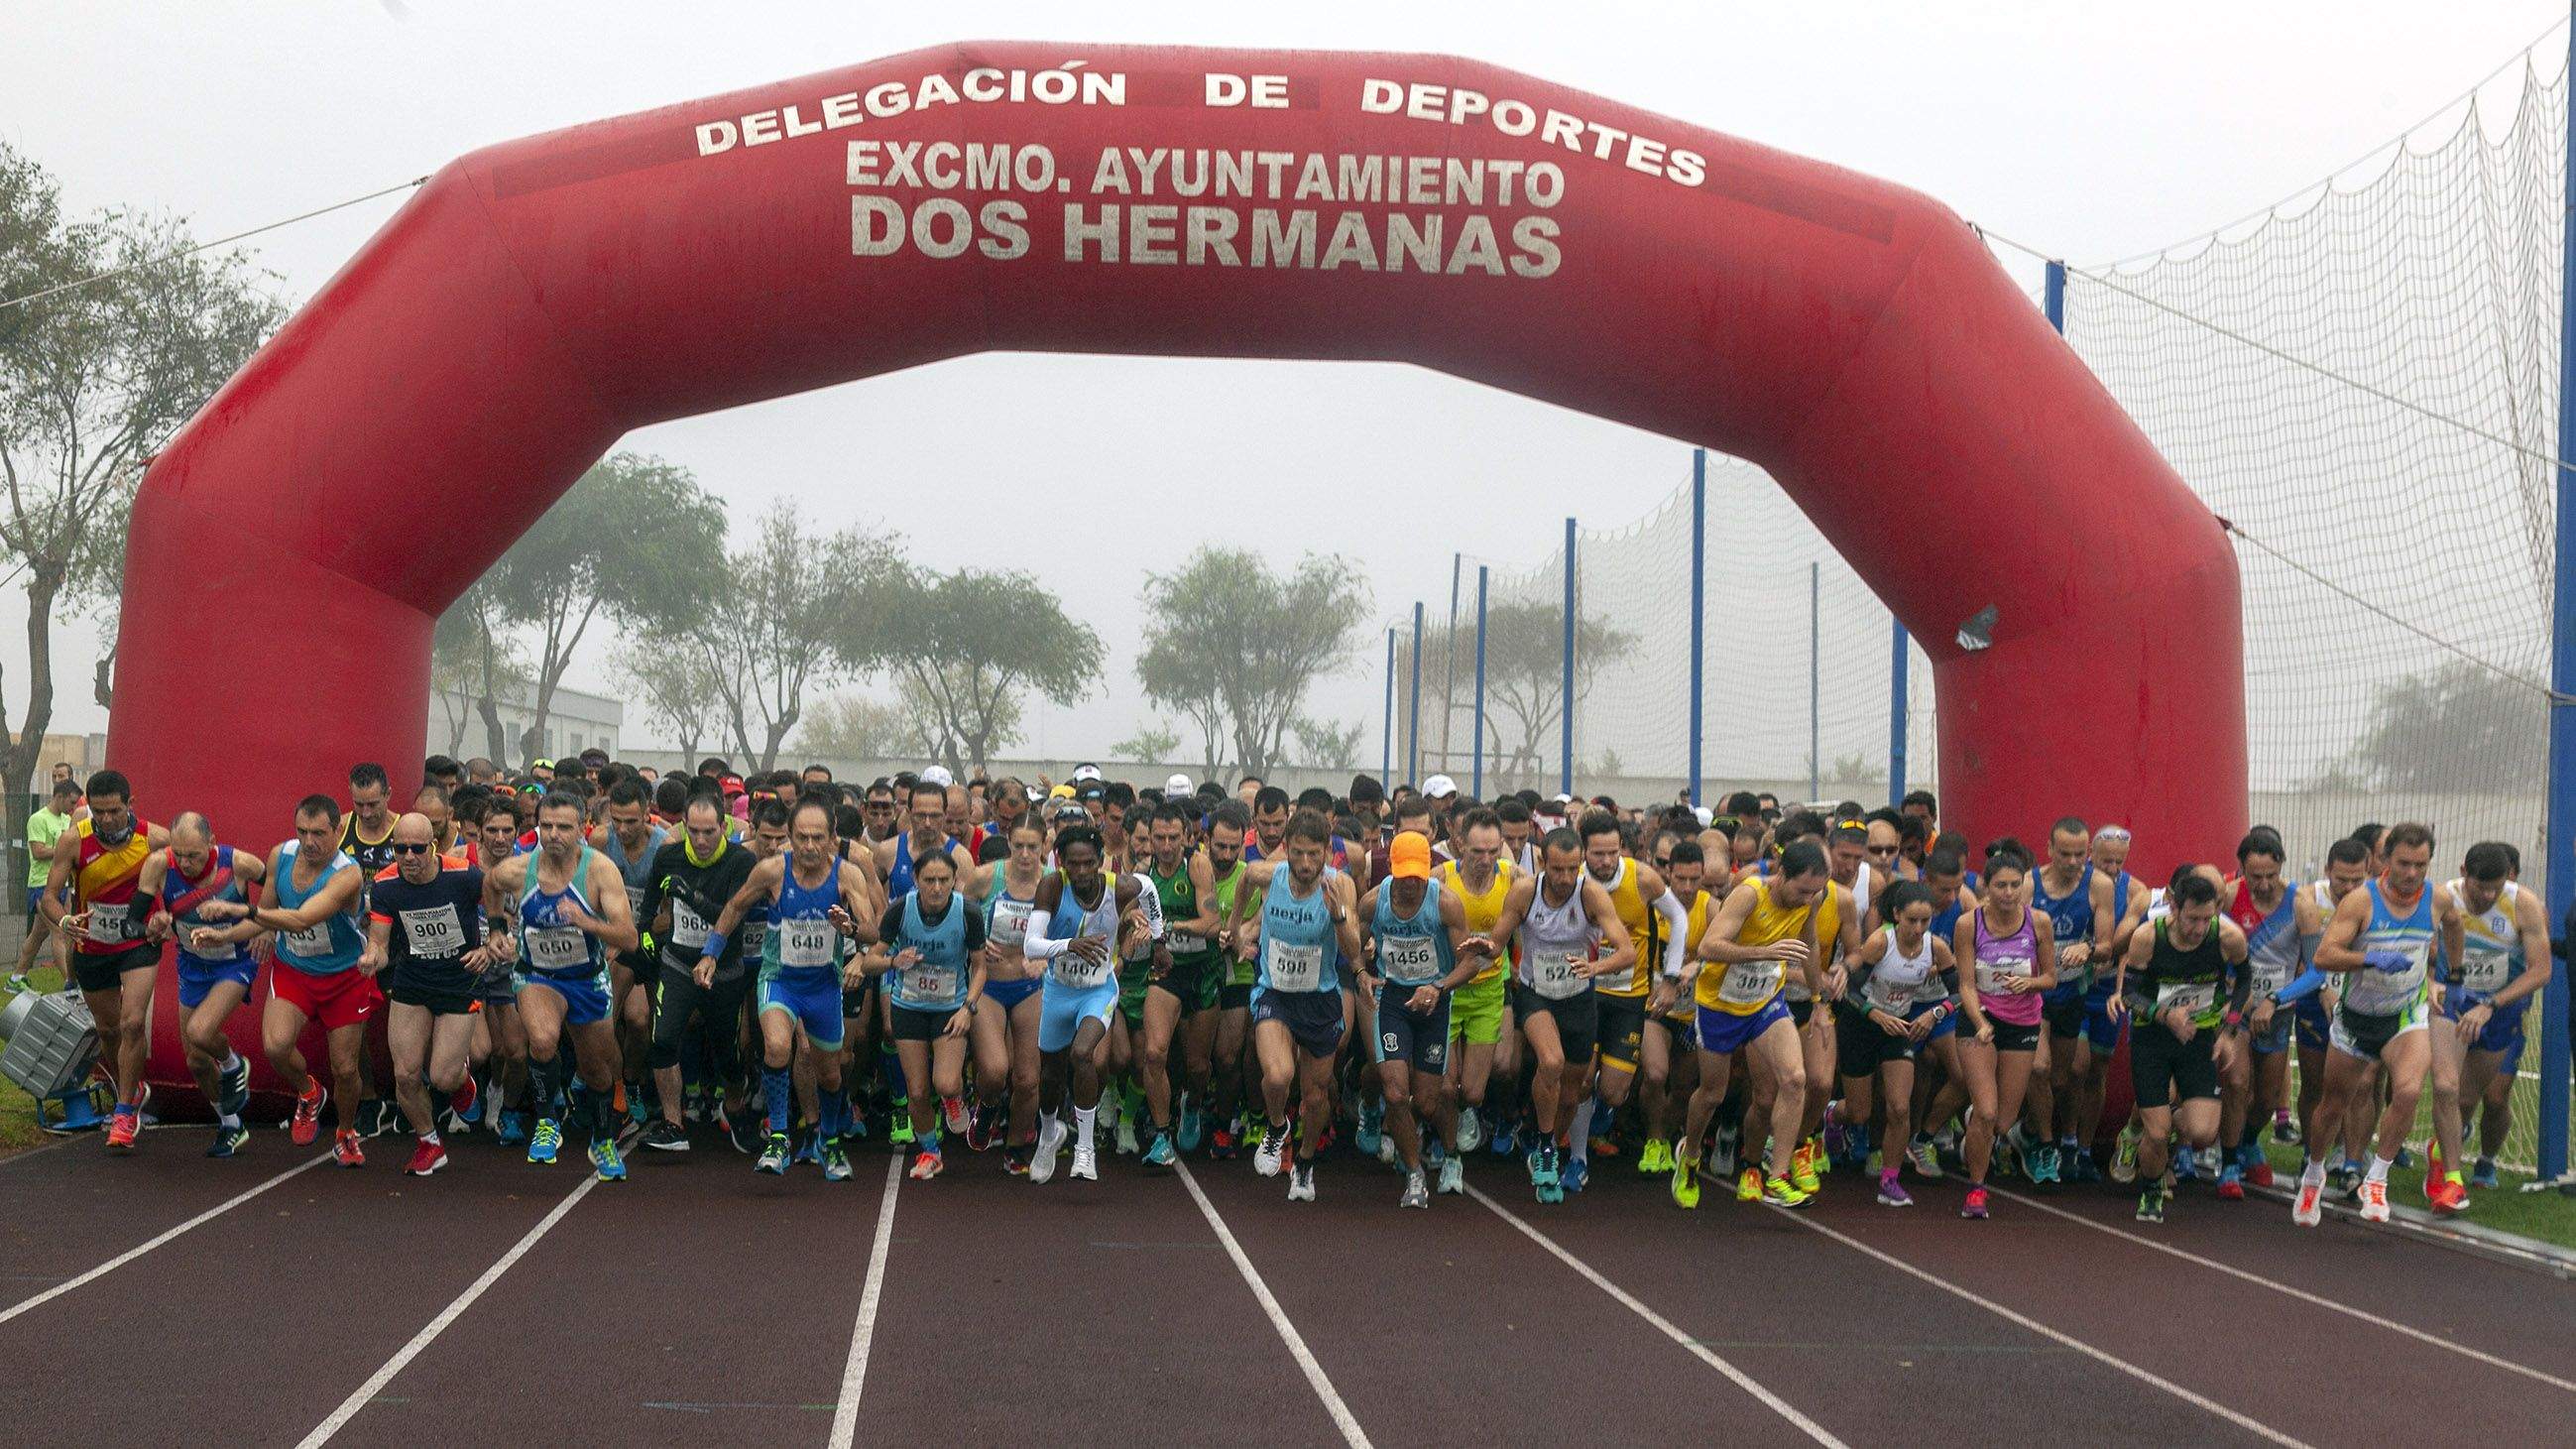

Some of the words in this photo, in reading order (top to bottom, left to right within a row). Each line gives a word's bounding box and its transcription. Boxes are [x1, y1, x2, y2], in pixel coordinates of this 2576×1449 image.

[695, 60, 1125, 157] DELEGACIÓN
[1204, 72, 1290, 109] DE
[1361, 77, 1707, 187] DEPORTES
[846, 140, 1070, 193] EXCMO.
[1091, 147, 1566, 208] AYUNTAMIENTO
[851, 194, 1031, 260] DOS
[1064, 202, 1563, 279] HERMANAS
[414, 921, 447, 938] 900
[538, 940, 573, 954] 650
[791, 933, 824, 950] 648
[1388, 949, 1430, 965] 1456
[918, 977, 938, 992] 85
